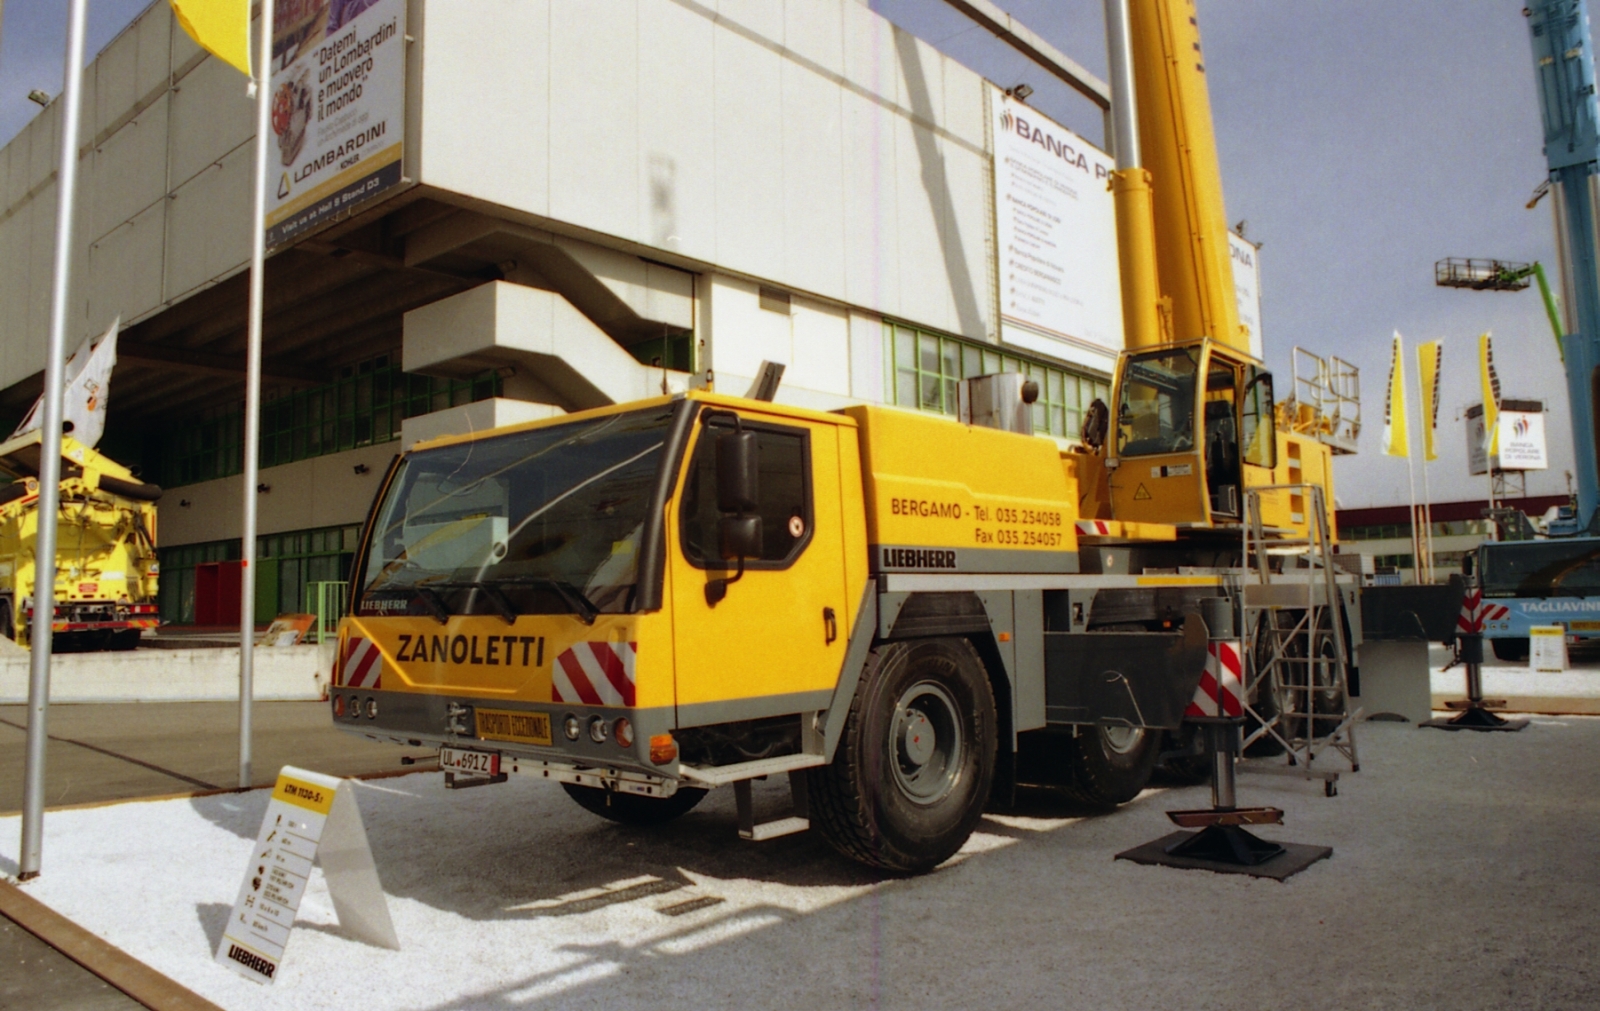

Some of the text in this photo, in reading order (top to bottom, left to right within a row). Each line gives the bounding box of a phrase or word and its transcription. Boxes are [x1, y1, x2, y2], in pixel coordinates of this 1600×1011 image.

[319, 16, 397, 83] un Lombardini
[318, 52, 374, 103] e muoverò
[318, 103, 324, 122] il
[294, 120, 386, 184] LOMBARDINI
[1016, 116, 1090, 174] BANCA
[282, 220, 298, 234] Visit
[300, 216, 307, 225] us
[309, 210, 317, 220] at
[318, 201, 333, 215] Hall
[342, 184, 365, 203] Stand
[367, 177, 380, 190] D3
[891, 498, 962, 519] BERGAMO
[974, 505, 993, 523] Tel.
[996, 508, 1062, 527] 035.254058
[975, 528, 1062, 546] Fax 035.254057
[883, 548, 957, 569] LIEBHERR
[361, 599, 408, 610] LIEBHERR
[396, 634, 545, 667] ZANOLETTI
[227, 944, 276, 979] LIEBHERR
